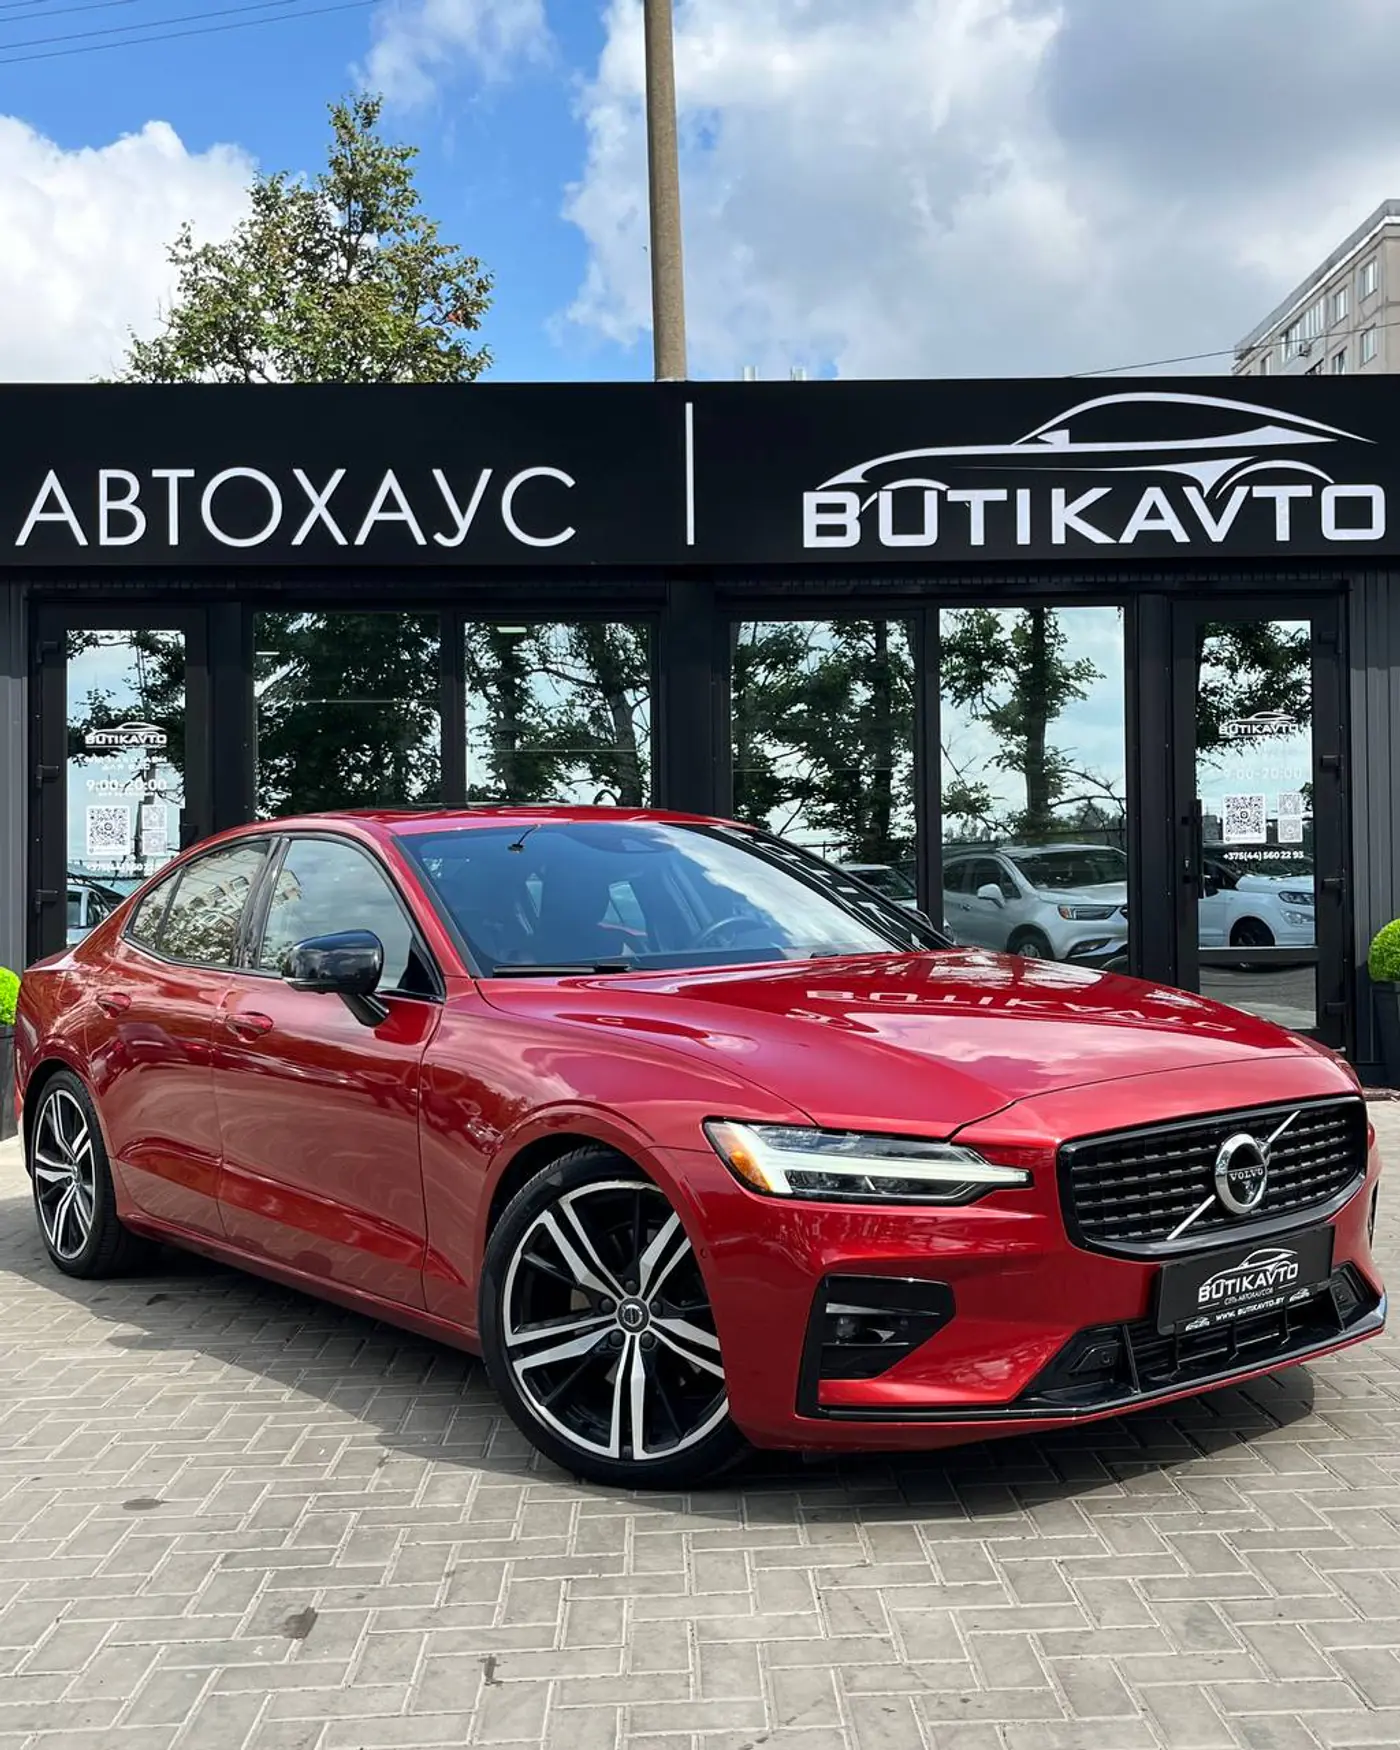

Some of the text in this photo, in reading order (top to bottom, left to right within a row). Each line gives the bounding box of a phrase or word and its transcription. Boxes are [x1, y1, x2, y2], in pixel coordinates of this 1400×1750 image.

[15, 466, 576, 547] АВТОХАУС
[803, 483, 1386, 548] BUTIKAVTO
[85, 733, 167, 745] BUTIKAVTO
[1223, 850, 1305, 861] +375(44) 560 22 93
[1229, 1168, 1264, 1181] VOLVO
[1197, 1262, 1299, 1303] BUTIKAVTO
